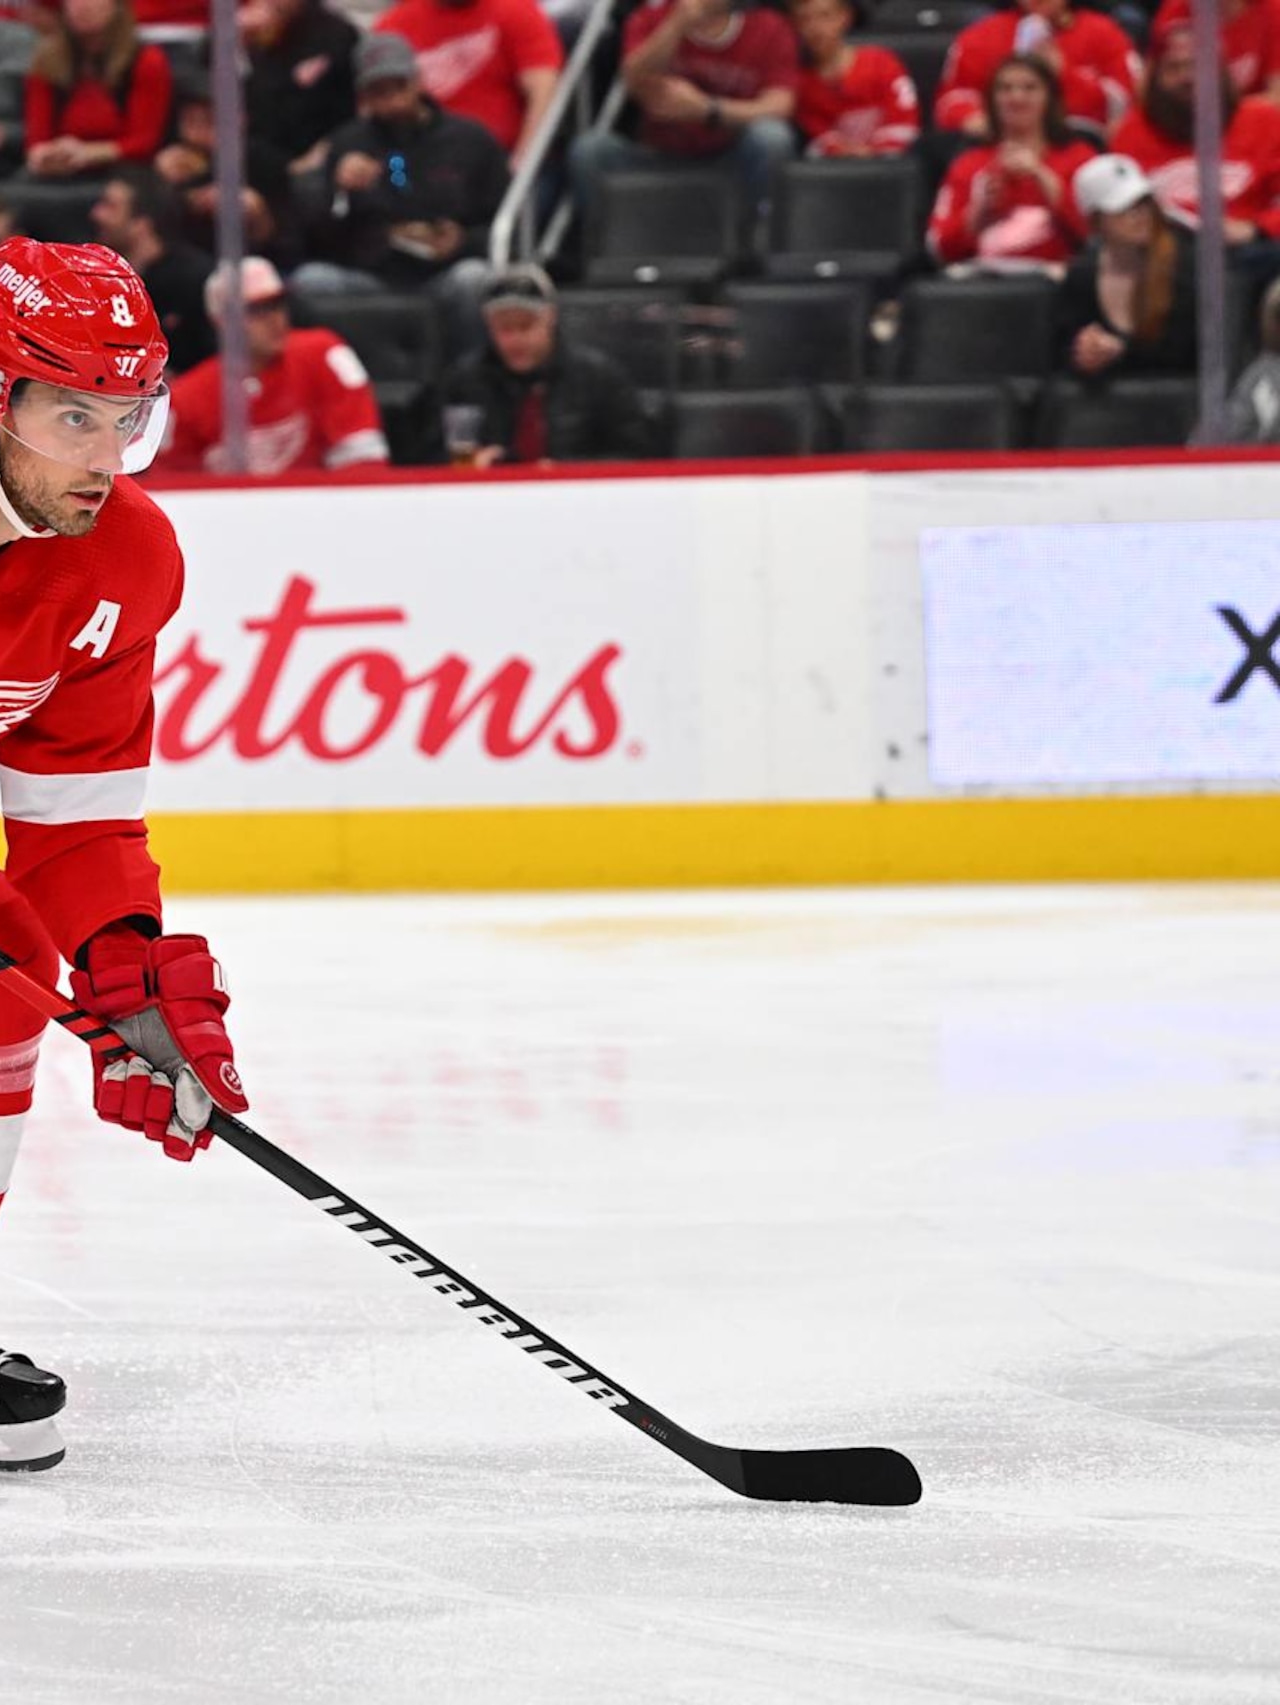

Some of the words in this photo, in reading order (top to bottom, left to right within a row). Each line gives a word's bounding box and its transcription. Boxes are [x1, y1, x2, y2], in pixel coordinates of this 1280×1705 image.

[111, 293, 137, 328] 8
[69, 599, 122, 660] A
[150, 571, 624, 765] rtons
[311, 1194, 632, 1409] WARRIOR
